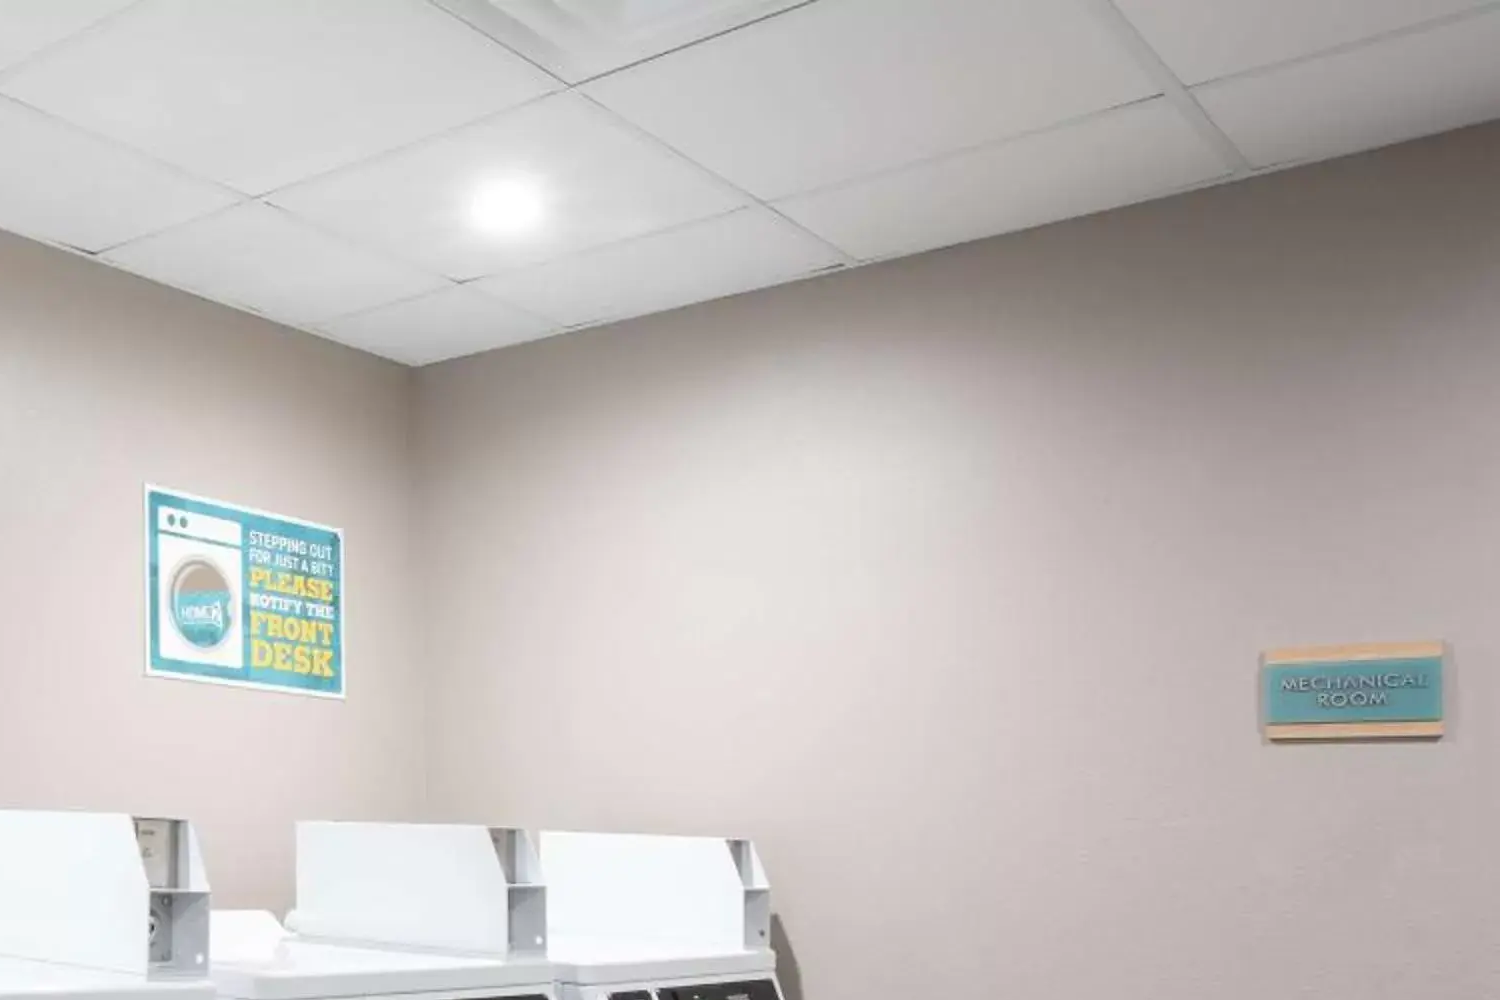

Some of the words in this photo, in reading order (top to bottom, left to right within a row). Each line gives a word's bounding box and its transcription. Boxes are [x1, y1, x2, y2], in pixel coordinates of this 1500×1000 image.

[250, 530, 307, 555] STEPPING
[309, 543, 332, 560] OUT
[249, 547, 271, 564] FOR
[275, 552, 299, 569] JUST
[301, 559, 309, 573] A
[311, 561, 334, 577] BIT?
[250, 566, 333, 602] PLEASE
[250, 592, 302, 615] NOTIFY
[305, 603, 334, 619] THE
[251, 610, 333, 645] FRONT
[252, 640, 334, 677] DESK
[1281, 673, 1429, 693] MECHANICAL
[1316, 691, 1388, 709] ROOM
